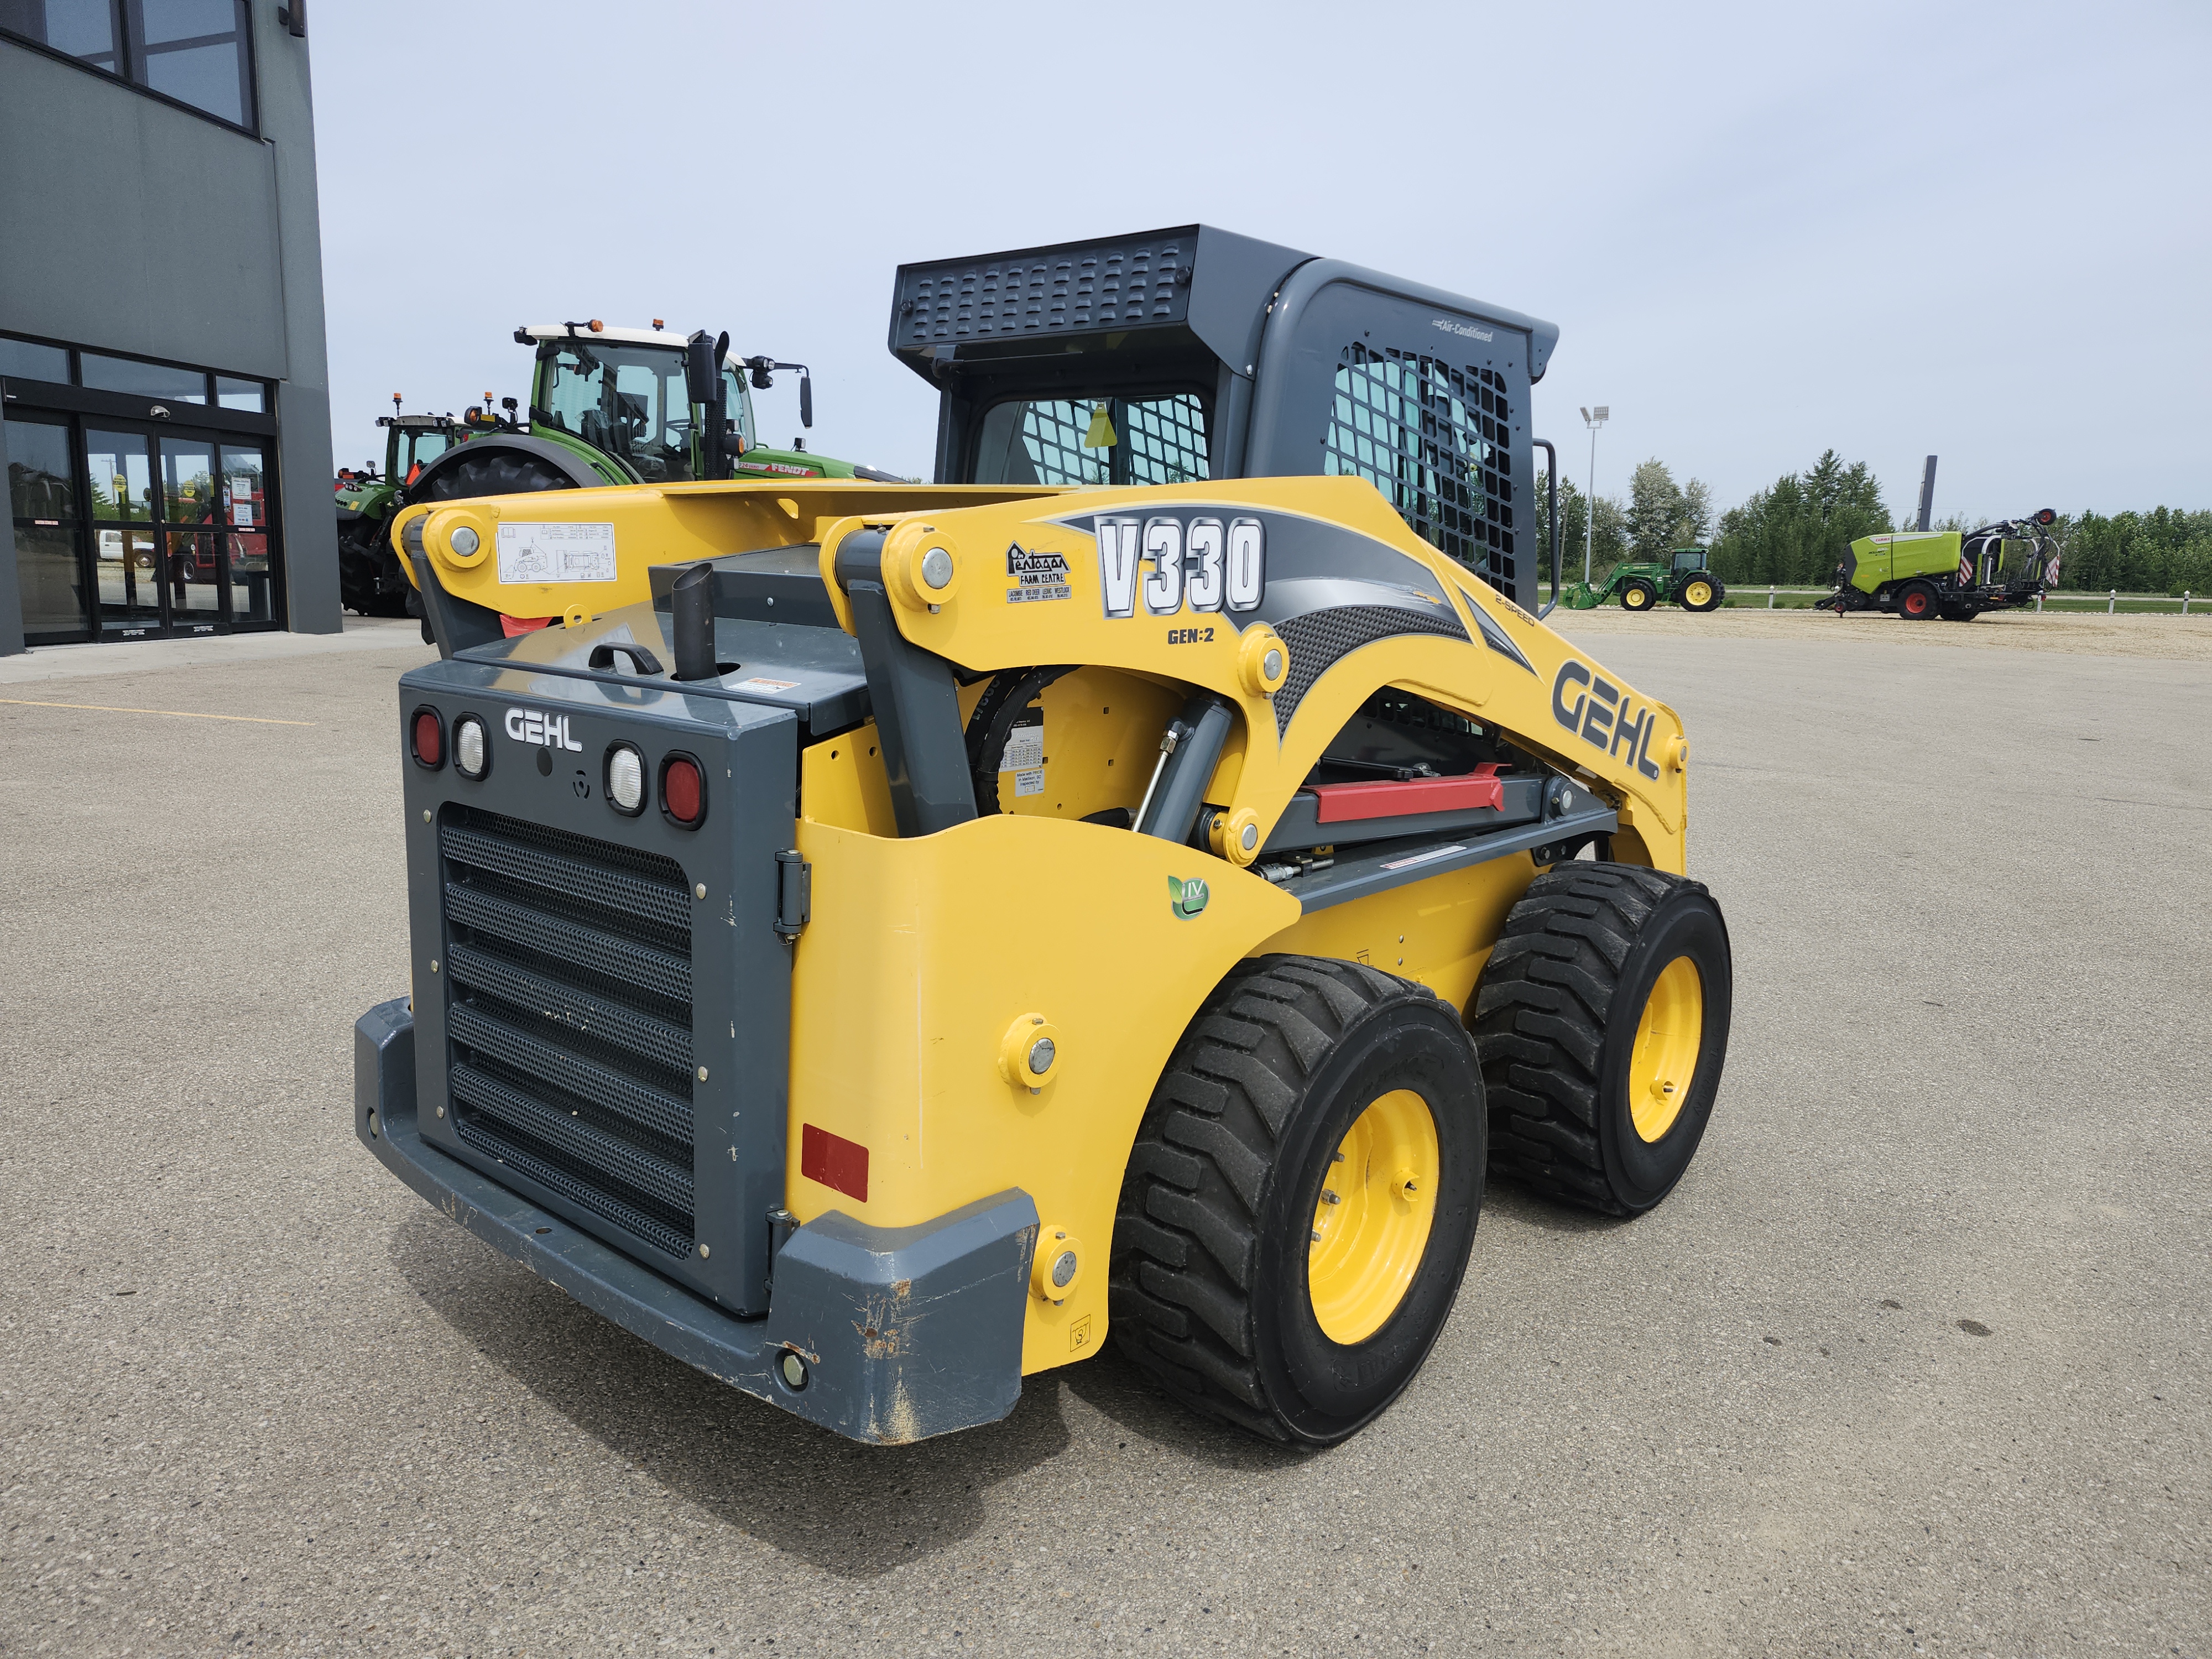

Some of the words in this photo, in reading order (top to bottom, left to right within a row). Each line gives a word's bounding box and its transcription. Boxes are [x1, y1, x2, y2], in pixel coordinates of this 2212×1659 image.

[1442, 320, 1493, 342] Air-Conditioned
[771, 463, 809, 476] FENDT
[1008, 543, 1069, 574] Pentagon
[1094, 516, 1265, 619] V330
[1020, 575, 1039, 585] FARM
[1041, 573, 1064, 583] CENTRE
[1495, 594, 1535, 627] 2-SPEED
[1167, 627, 1214, 645] GEN:2
[505, 707, 583, 753] GEHL
[1551, 658, 1660, 781] GEHL
[1188, 879, 1204, 898] IV
